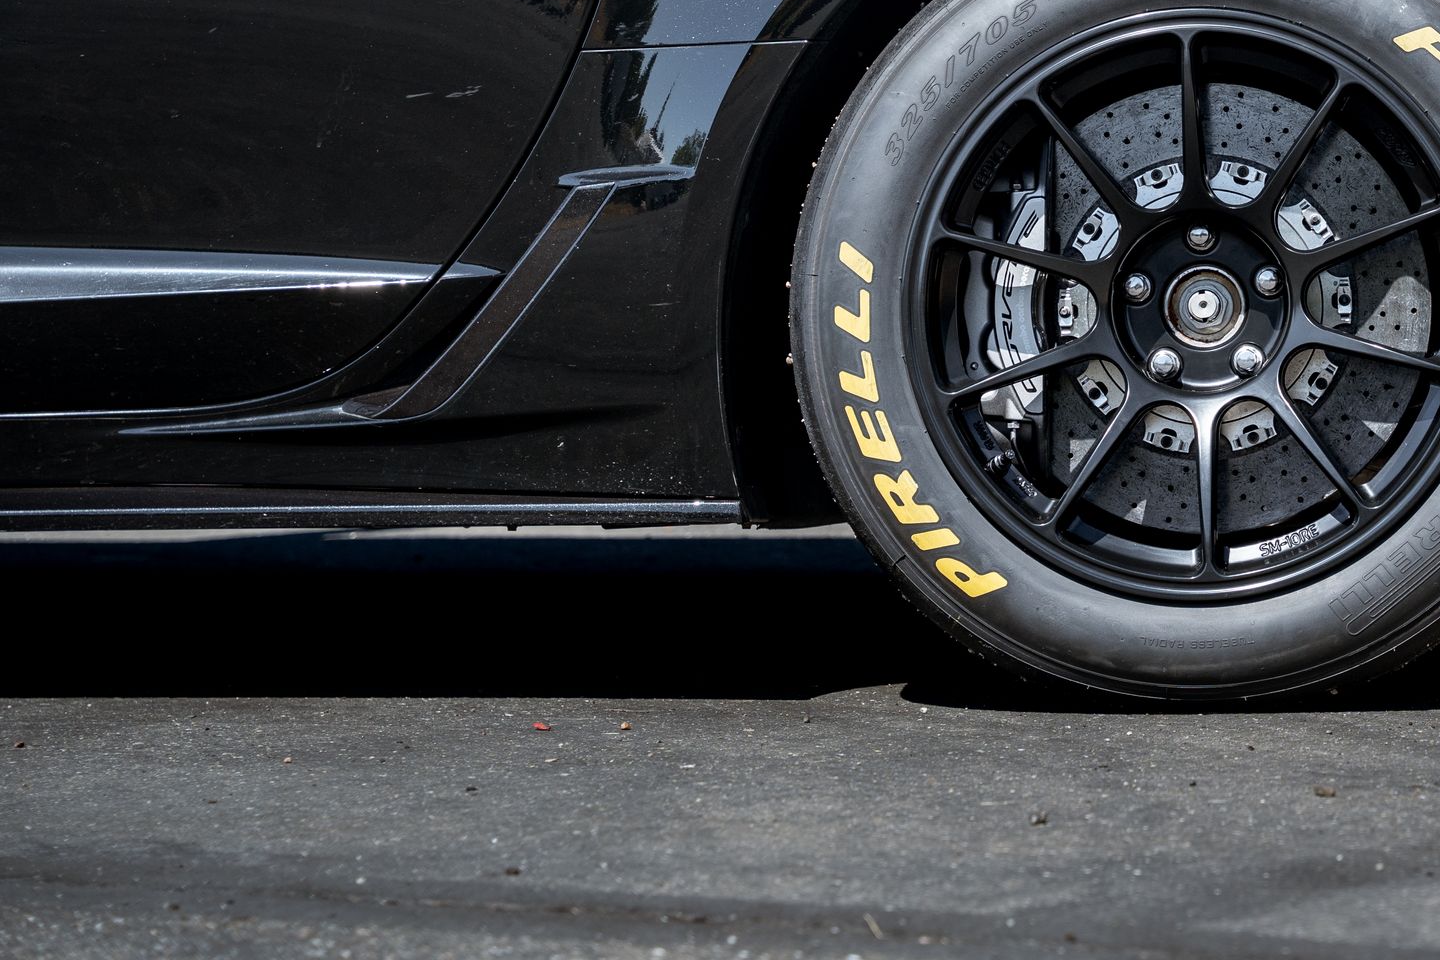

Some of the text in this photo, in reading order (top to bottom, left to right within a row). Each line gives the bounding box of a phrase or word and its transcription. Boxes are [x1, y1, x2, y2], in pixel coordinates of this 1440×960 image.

[944, 22, 1048, 109] FOR COMPETITION USE ONLY
[831, 240, 1008, 599] PIRELLI
[1258, 524, 1320, 558] SM-10RE
[1140, 636, 1255, 649] TUBELESS RADIAL
